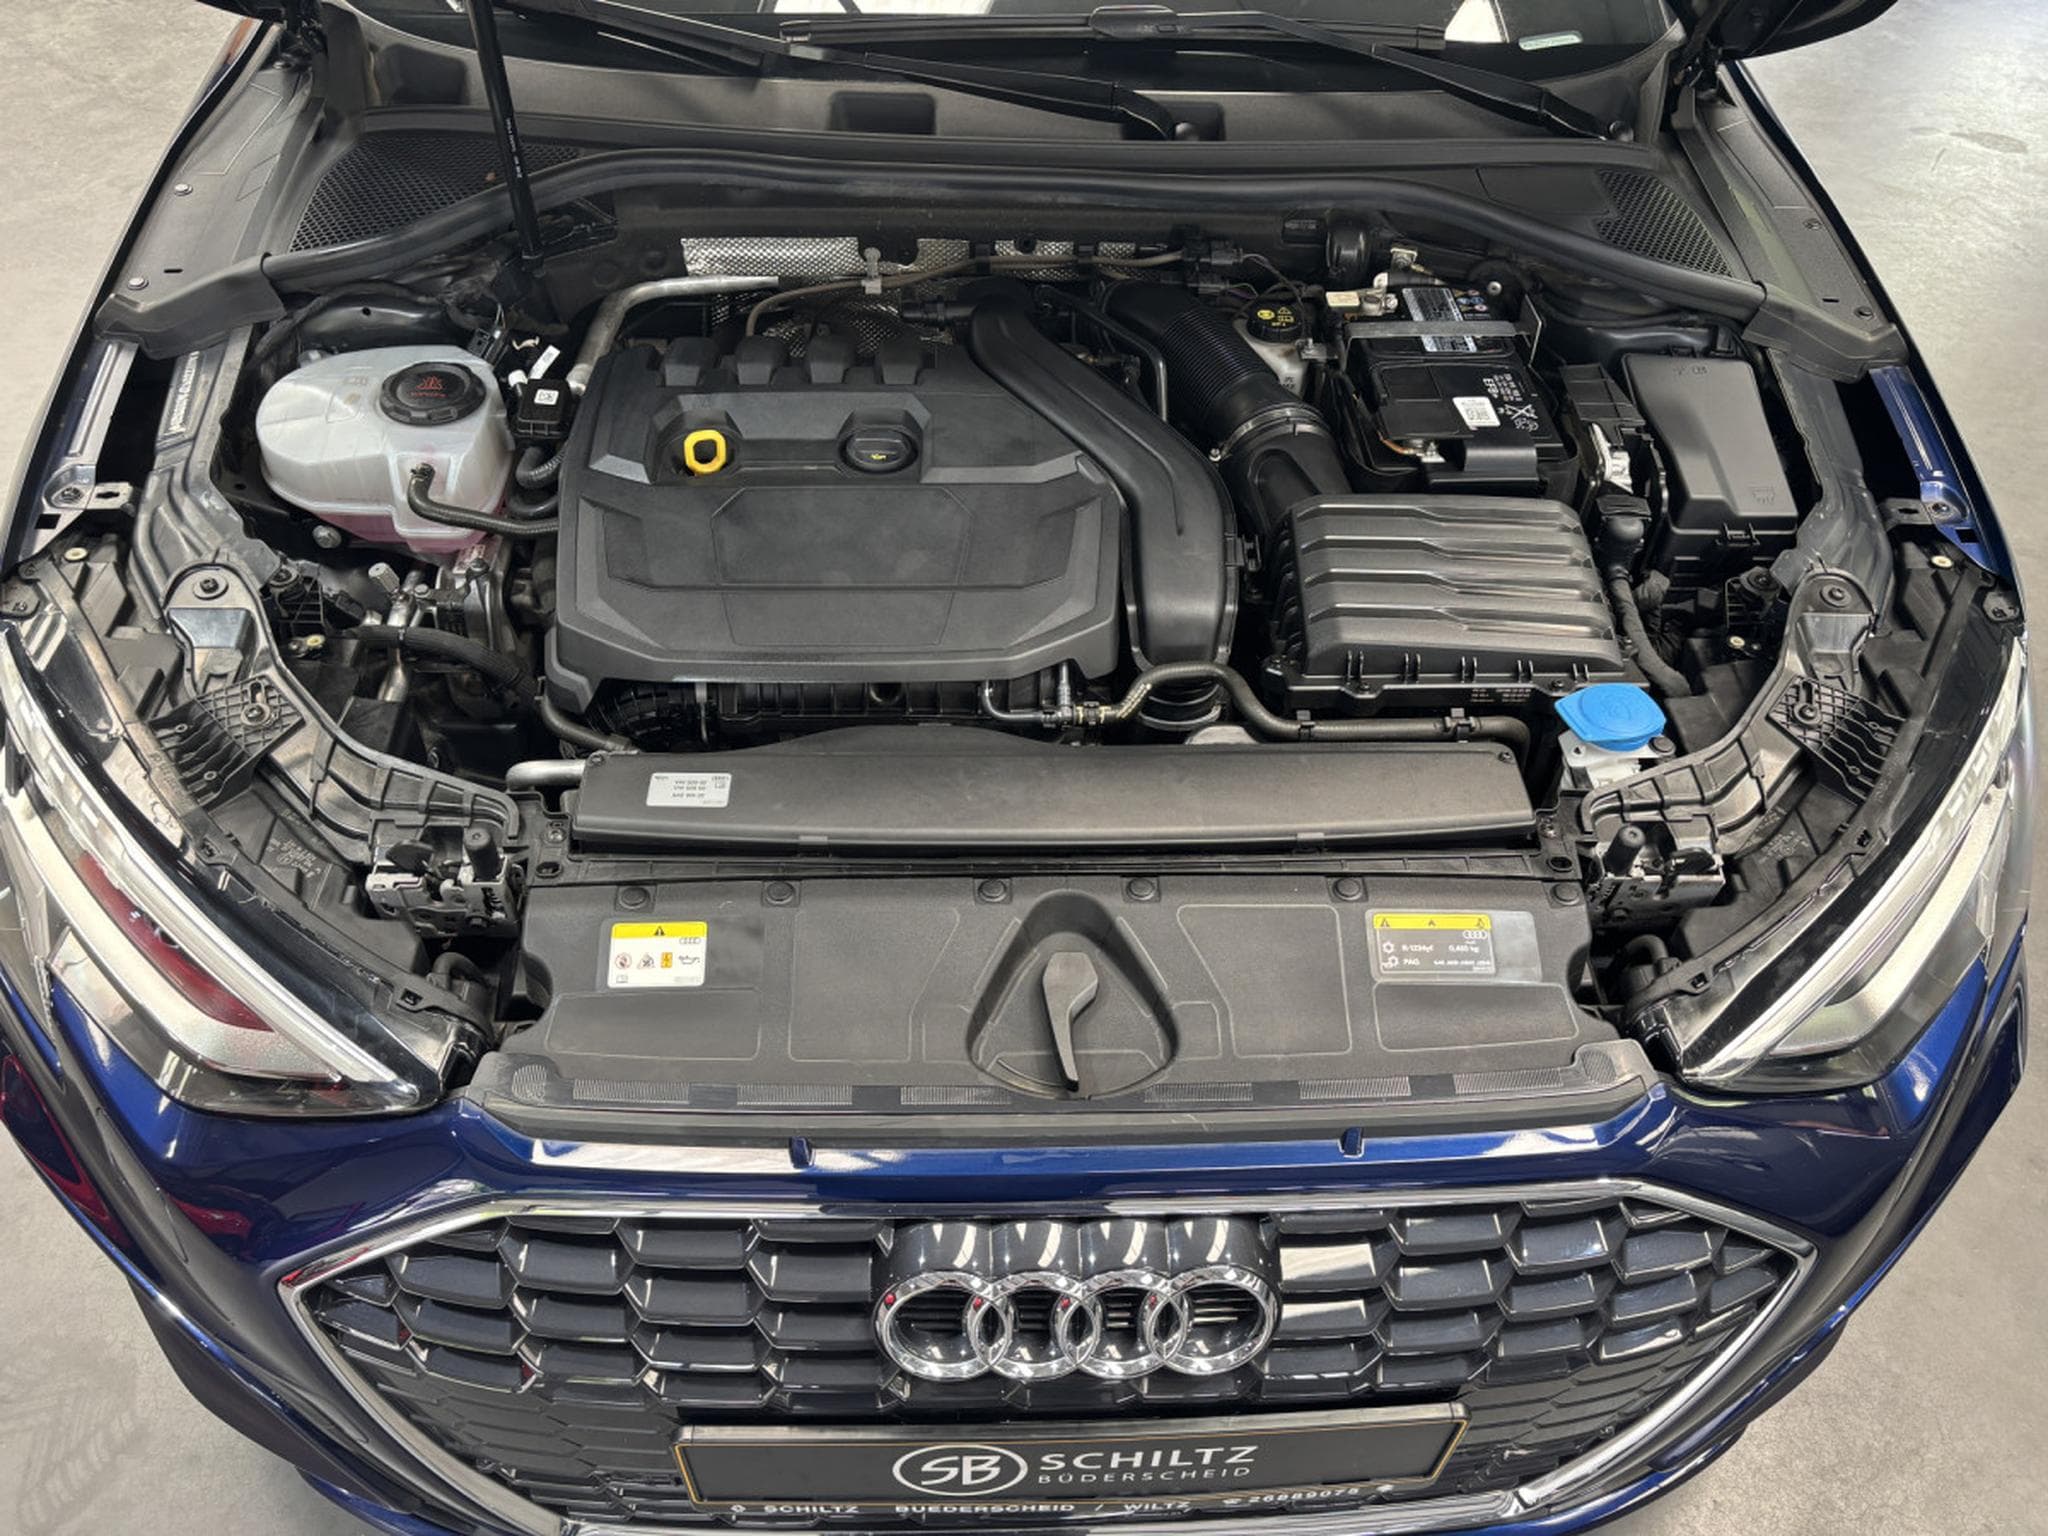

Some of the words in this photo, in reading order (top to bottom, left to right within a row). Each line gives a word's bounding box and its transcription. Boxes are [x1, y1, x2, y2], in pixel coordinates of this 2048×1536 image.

[1040, 1446, 1259, 1471] SCHILTZ
[920, 1455, 1002, 1486] SB
[1037, 1466, 1251, 1485] BÜDERSCHEID
[764, 1504, 859, 1514] SCHILTZ
[1124, 1500, 1192, 1513] WILTZ
